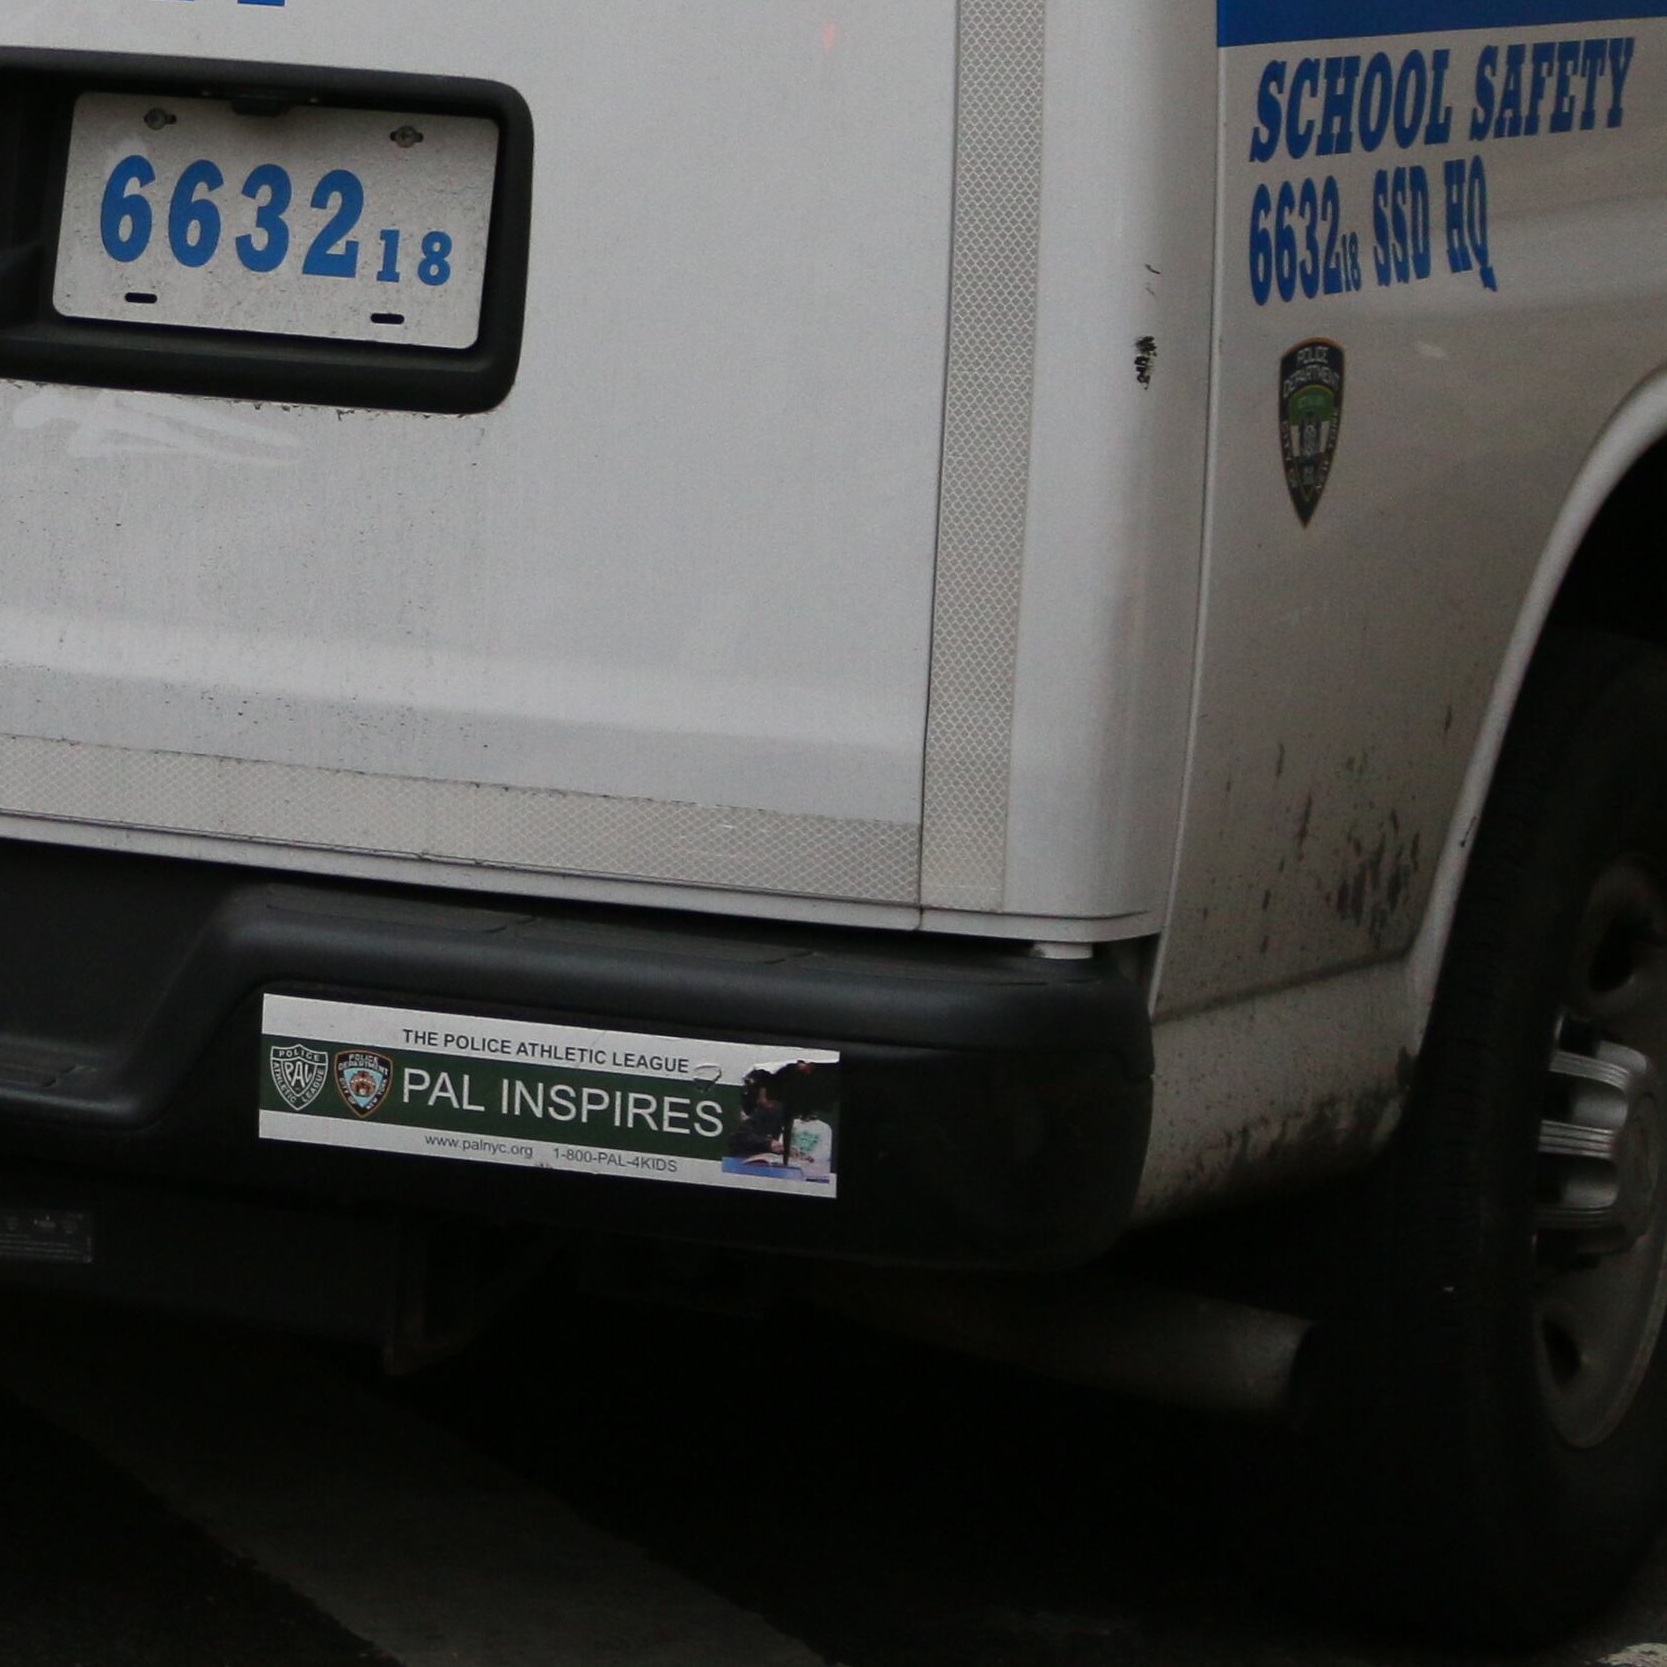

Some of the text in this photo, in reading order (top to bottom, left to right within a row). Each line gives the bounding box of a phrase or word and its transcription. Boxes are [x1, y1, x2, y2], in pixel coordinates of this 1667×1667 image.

[1249, 37, 1635, 162] SCHOOL SAFETY
[1373, 165, 1431, 286] SSD
[1444, 155, 1497, 292] HQ
[279, 1049, 320, 1061] POLICE
[403, 1029, 689, 1074] THE POLICE ATHLETIC LEAGUE
[284, 1061, 313, 1088] PAL
[302, 1068, 325, 1103] LEAGUE
[402, 1067, 724, 1137] PAL INSPIRES
[425, 1134, 678, 1172] www.palnyc.org 1-800-PAL-4KIDS
